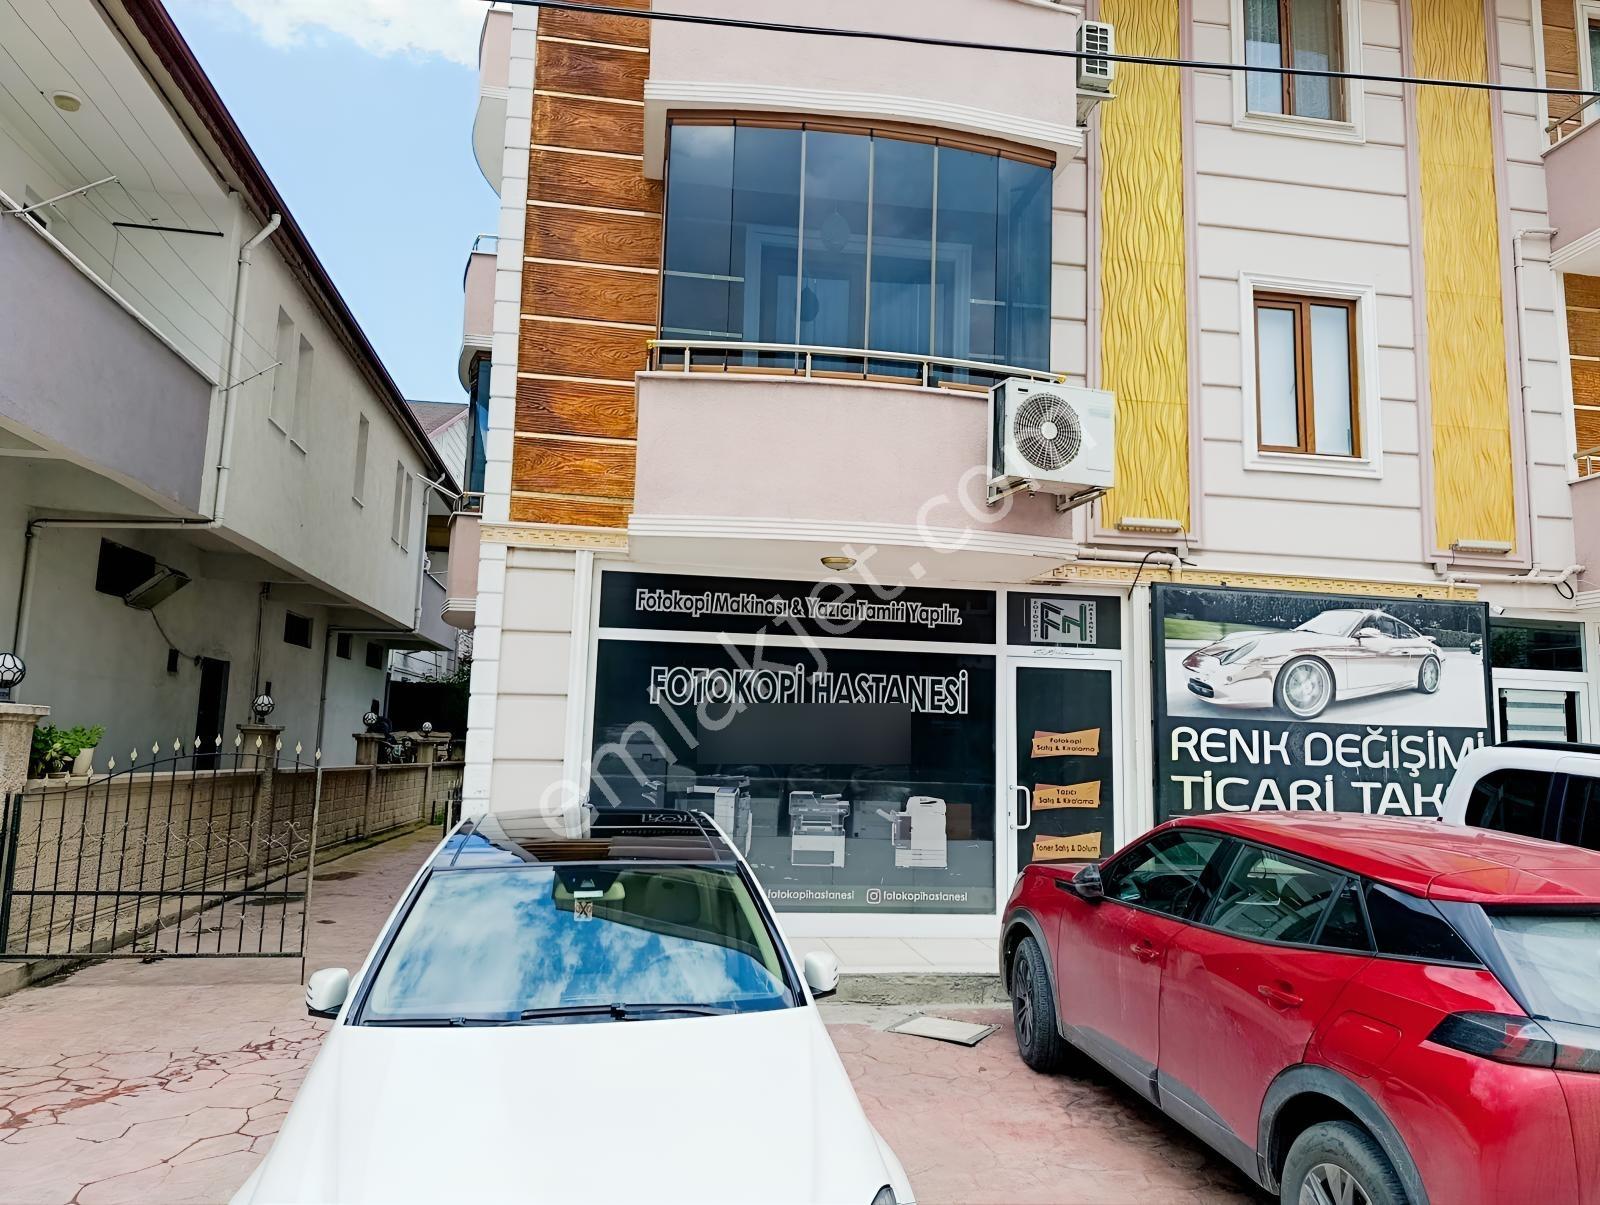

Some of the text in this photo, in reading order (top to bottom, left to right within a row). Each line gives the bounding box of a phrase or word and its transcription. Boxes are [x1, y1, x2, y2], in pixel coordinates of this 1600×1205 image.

[636, 589, 962, 628] Fotokopi Makinası & Yazıcı Tamiri Yapılır.
[650, 662, 968, 715] FOTOKOPİ HASTANESİ
[1050, 737, 1082, 745] Fotokopi
[1171, 726, 1291, 766] RENK
[1170, 770, 1446, 816] TİCARİ TAK
[1036, 844, 1054, 852] Toner
[1077, 844, 1098, 852] Dolum
[883, 890, 968, 902] fotokopihastanesi
